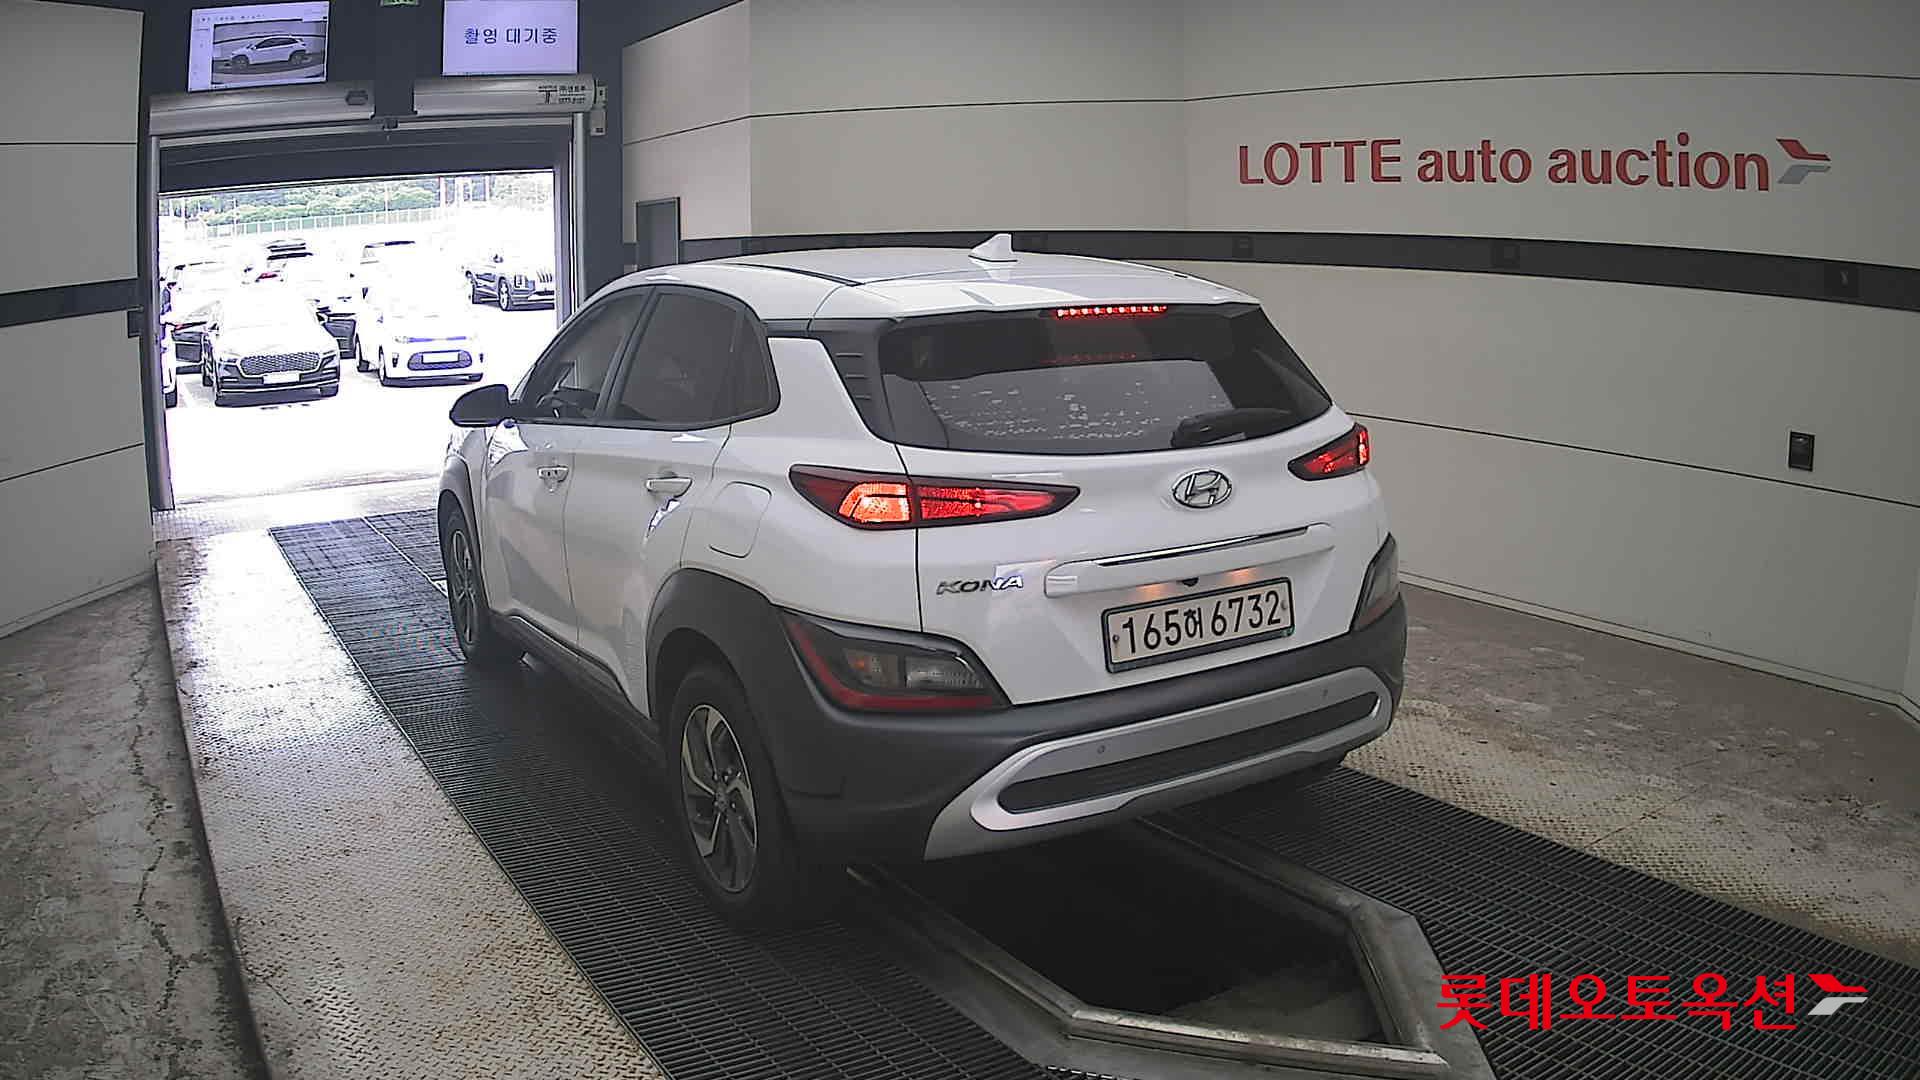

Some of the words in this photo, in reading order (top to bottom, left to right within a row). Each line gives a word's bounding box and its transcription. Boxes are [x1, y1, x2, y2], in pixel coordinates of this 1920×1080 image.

[506, 28, 557, 44] 대기중
[1239, 139, 1401, 186] LOTTE
[1416, 140, 1532, 183] auto
[1548, 132, 1770, 192] auction
[936, 575, 1024, 595] KONA
